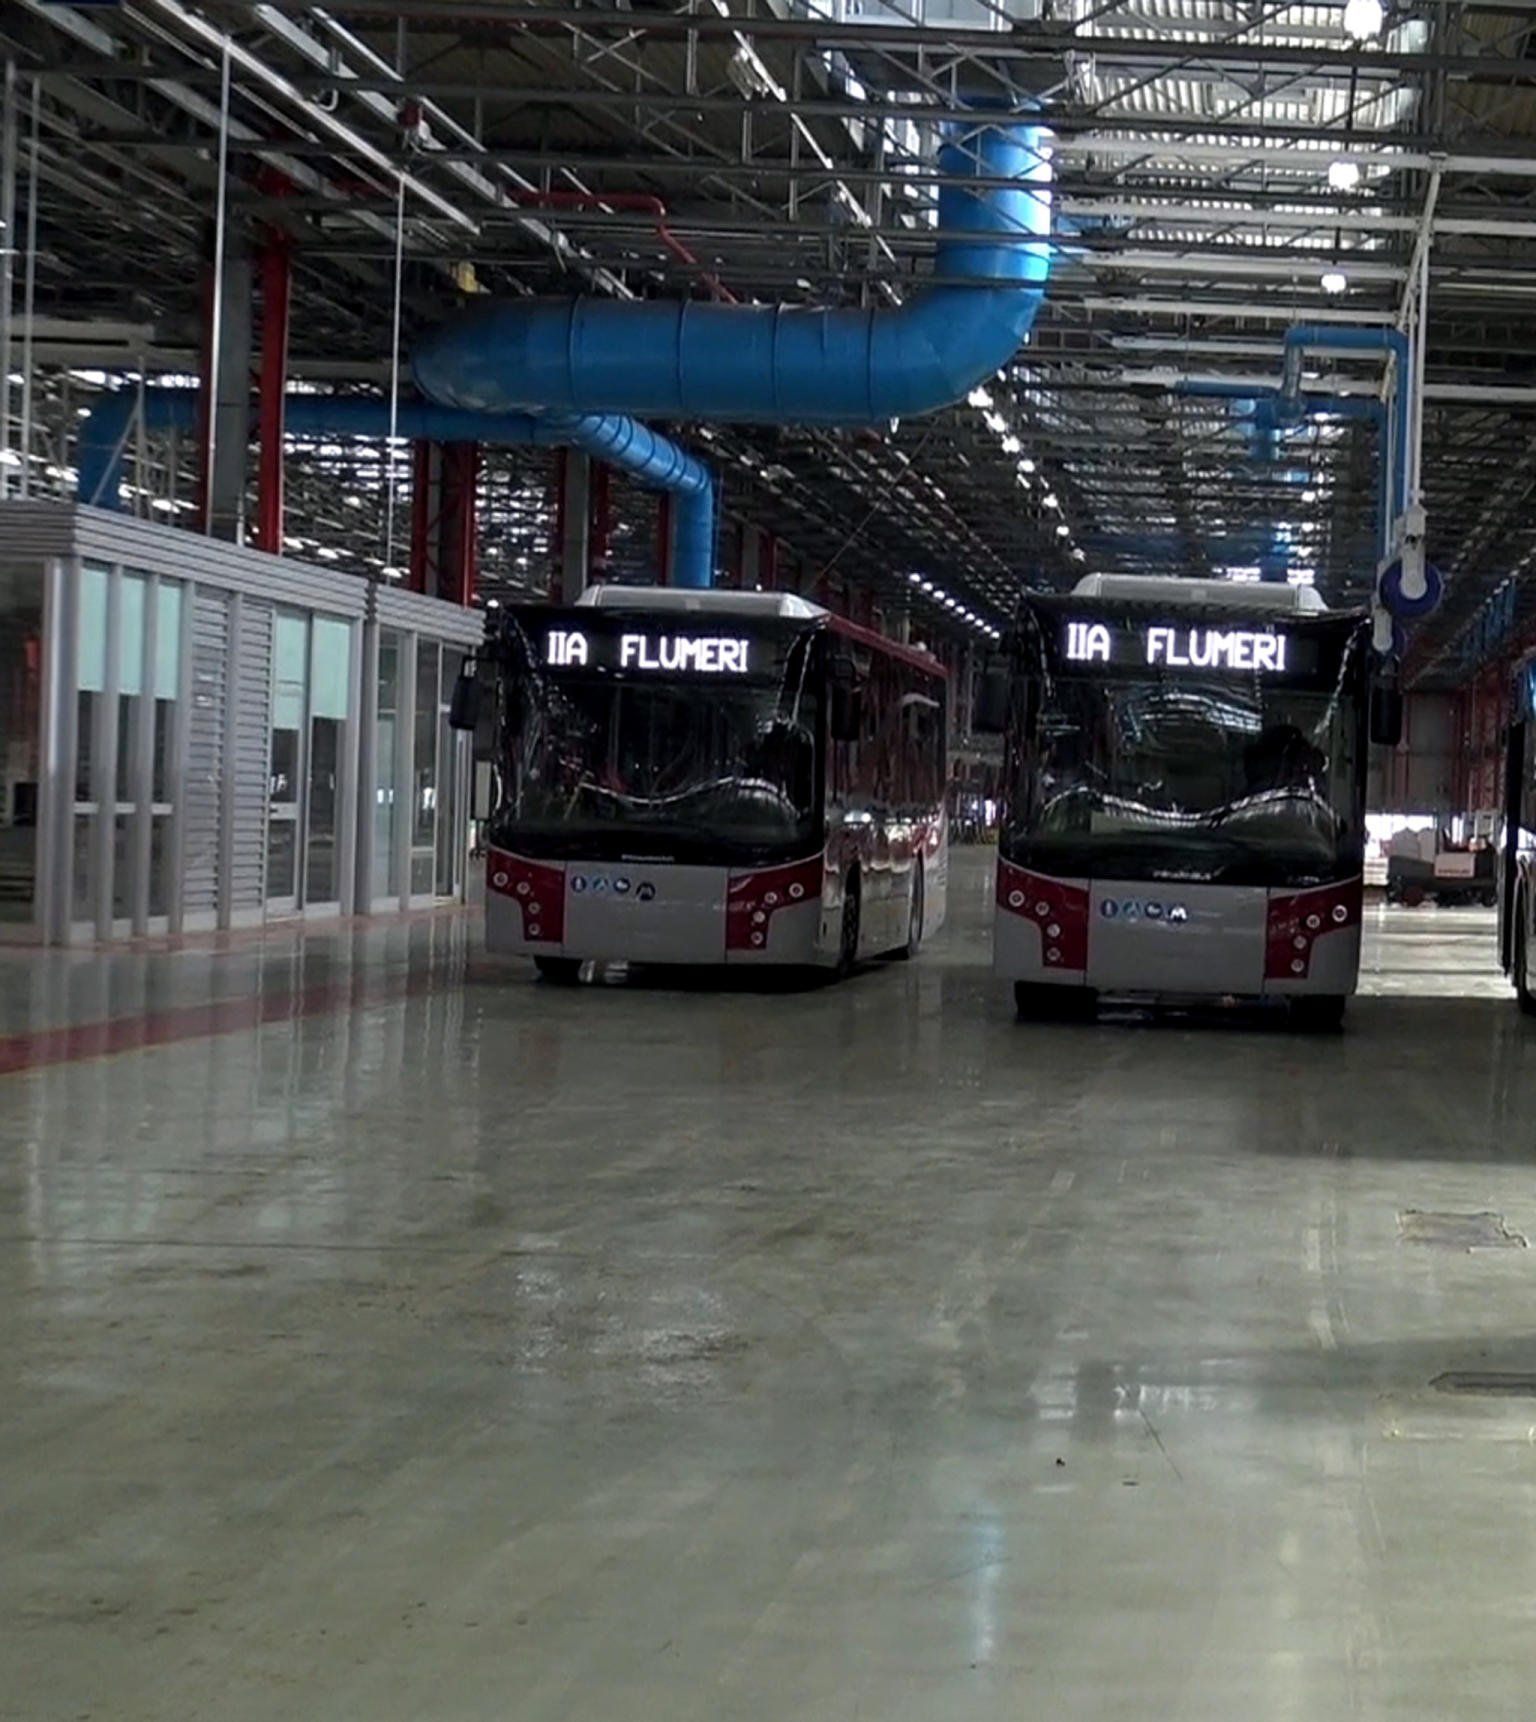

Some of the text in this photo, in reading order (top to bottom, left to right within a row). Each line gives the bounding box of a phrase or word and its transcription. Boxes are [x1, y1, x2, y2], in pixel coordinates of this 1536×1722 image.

[547, 631, 749, 673] IIA FLUMERI
[1066, 622, 1286, 671] IIA FLUMERI
